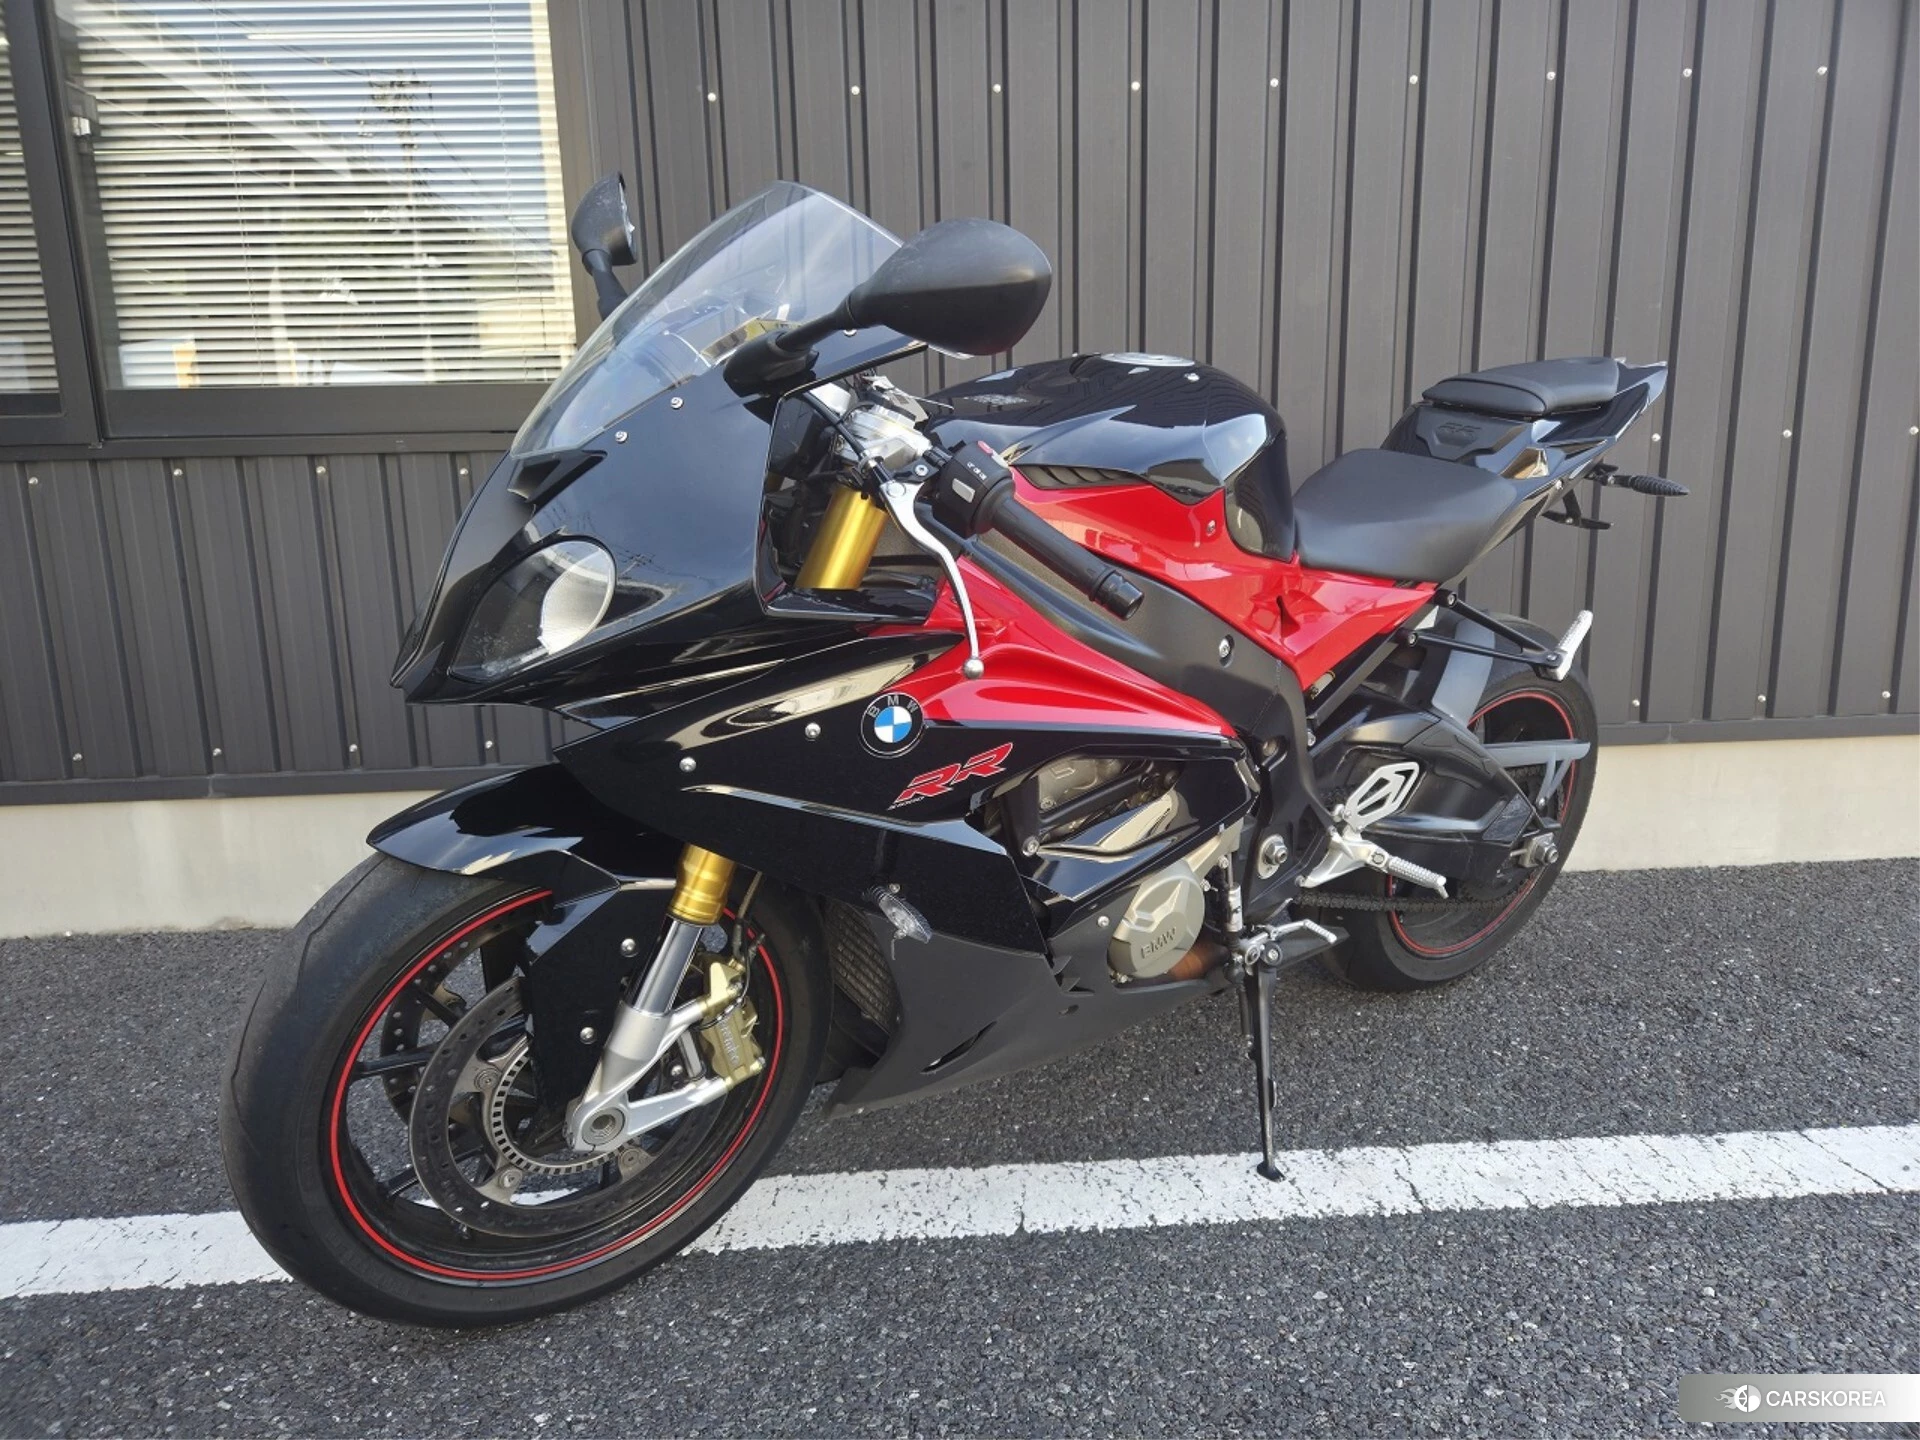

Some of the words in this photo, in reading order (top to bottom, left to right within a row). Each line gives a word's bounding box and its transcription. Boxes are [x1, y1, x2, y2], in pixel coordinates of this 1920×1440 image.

[867, 695, 918, 718] BMW
[893, 742, 1014, 804] RR
[1141, 928, 1176, 959] BMW
